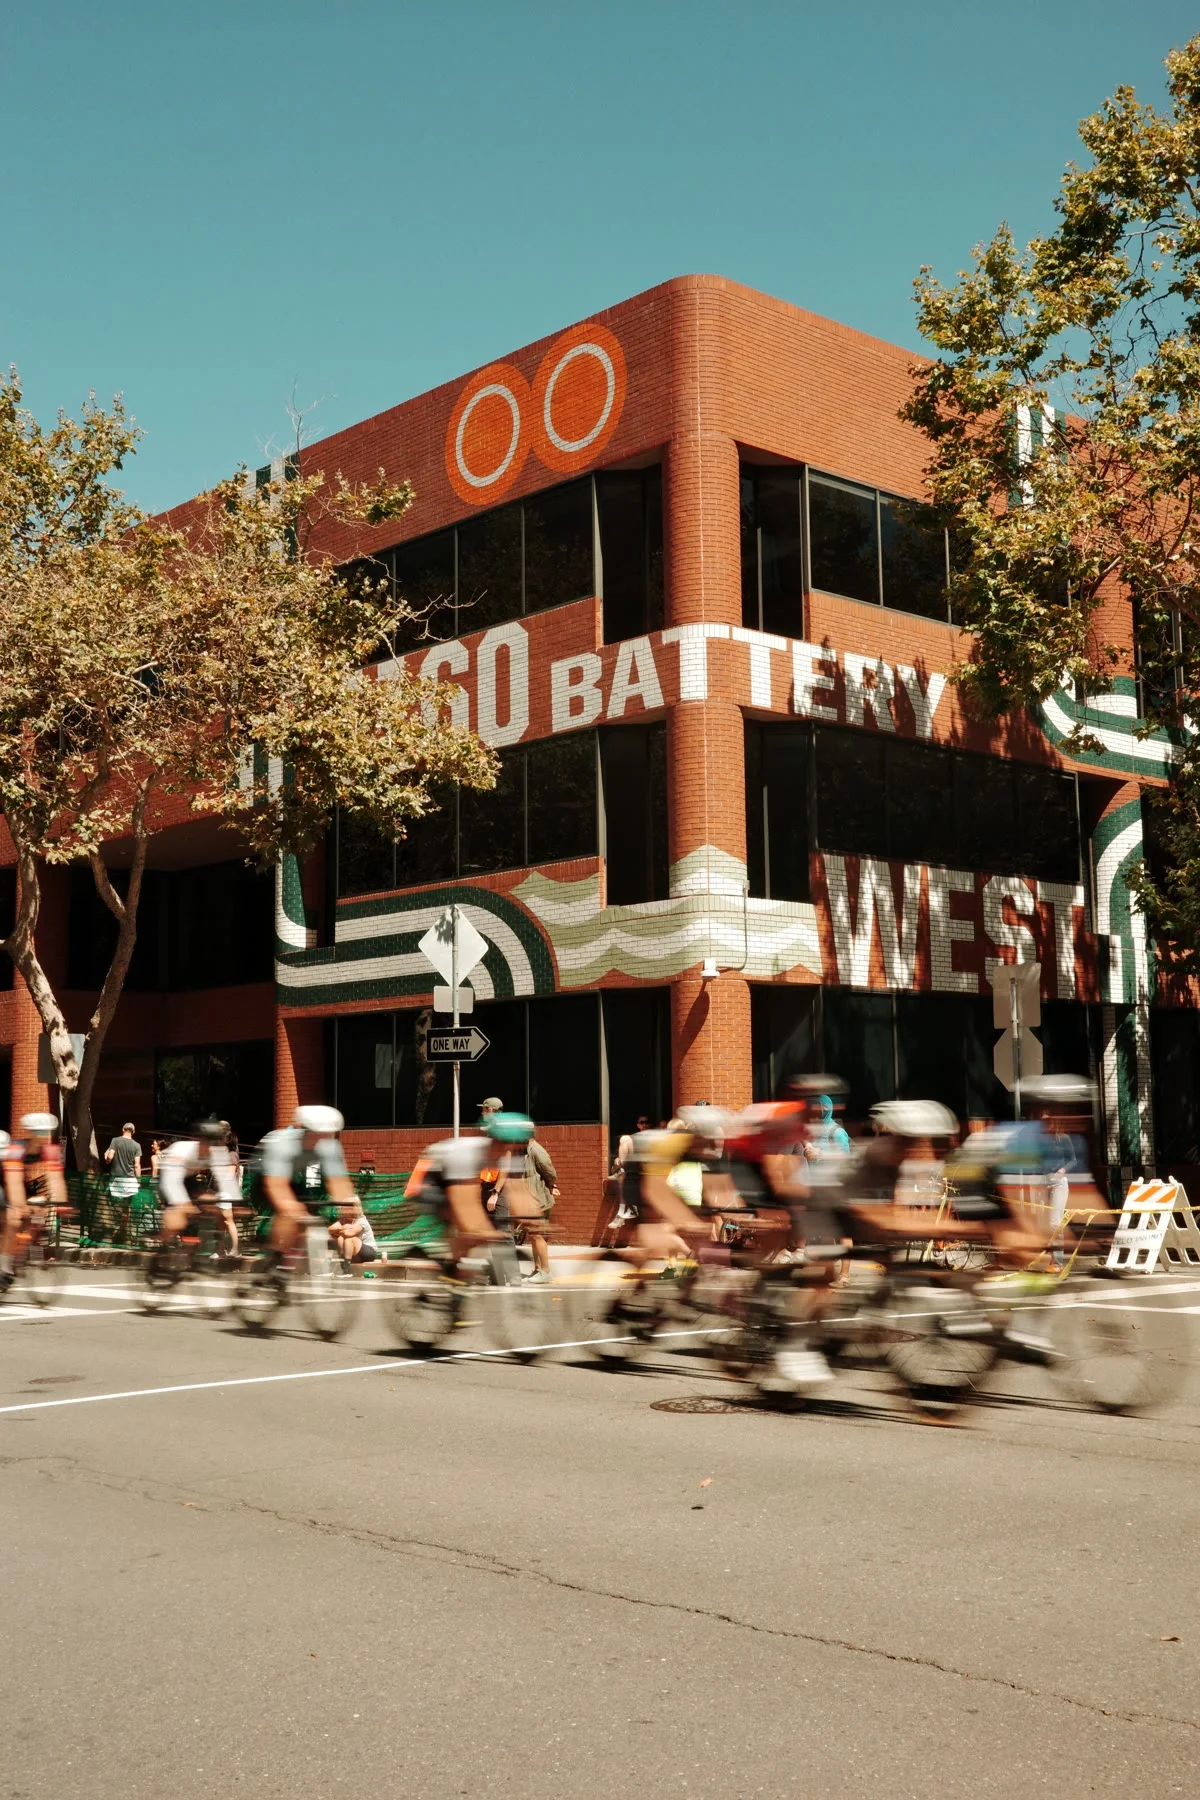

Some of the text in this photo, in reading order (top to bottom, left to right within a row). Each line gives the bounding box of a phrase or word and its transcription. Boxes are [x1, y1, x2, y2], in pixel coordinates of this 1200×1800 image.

[550, 623, 949, 739] BATTERY
[822, 852, 1085, 1000] WEST
[432, 1037, 471, 1051] ONE WAY
